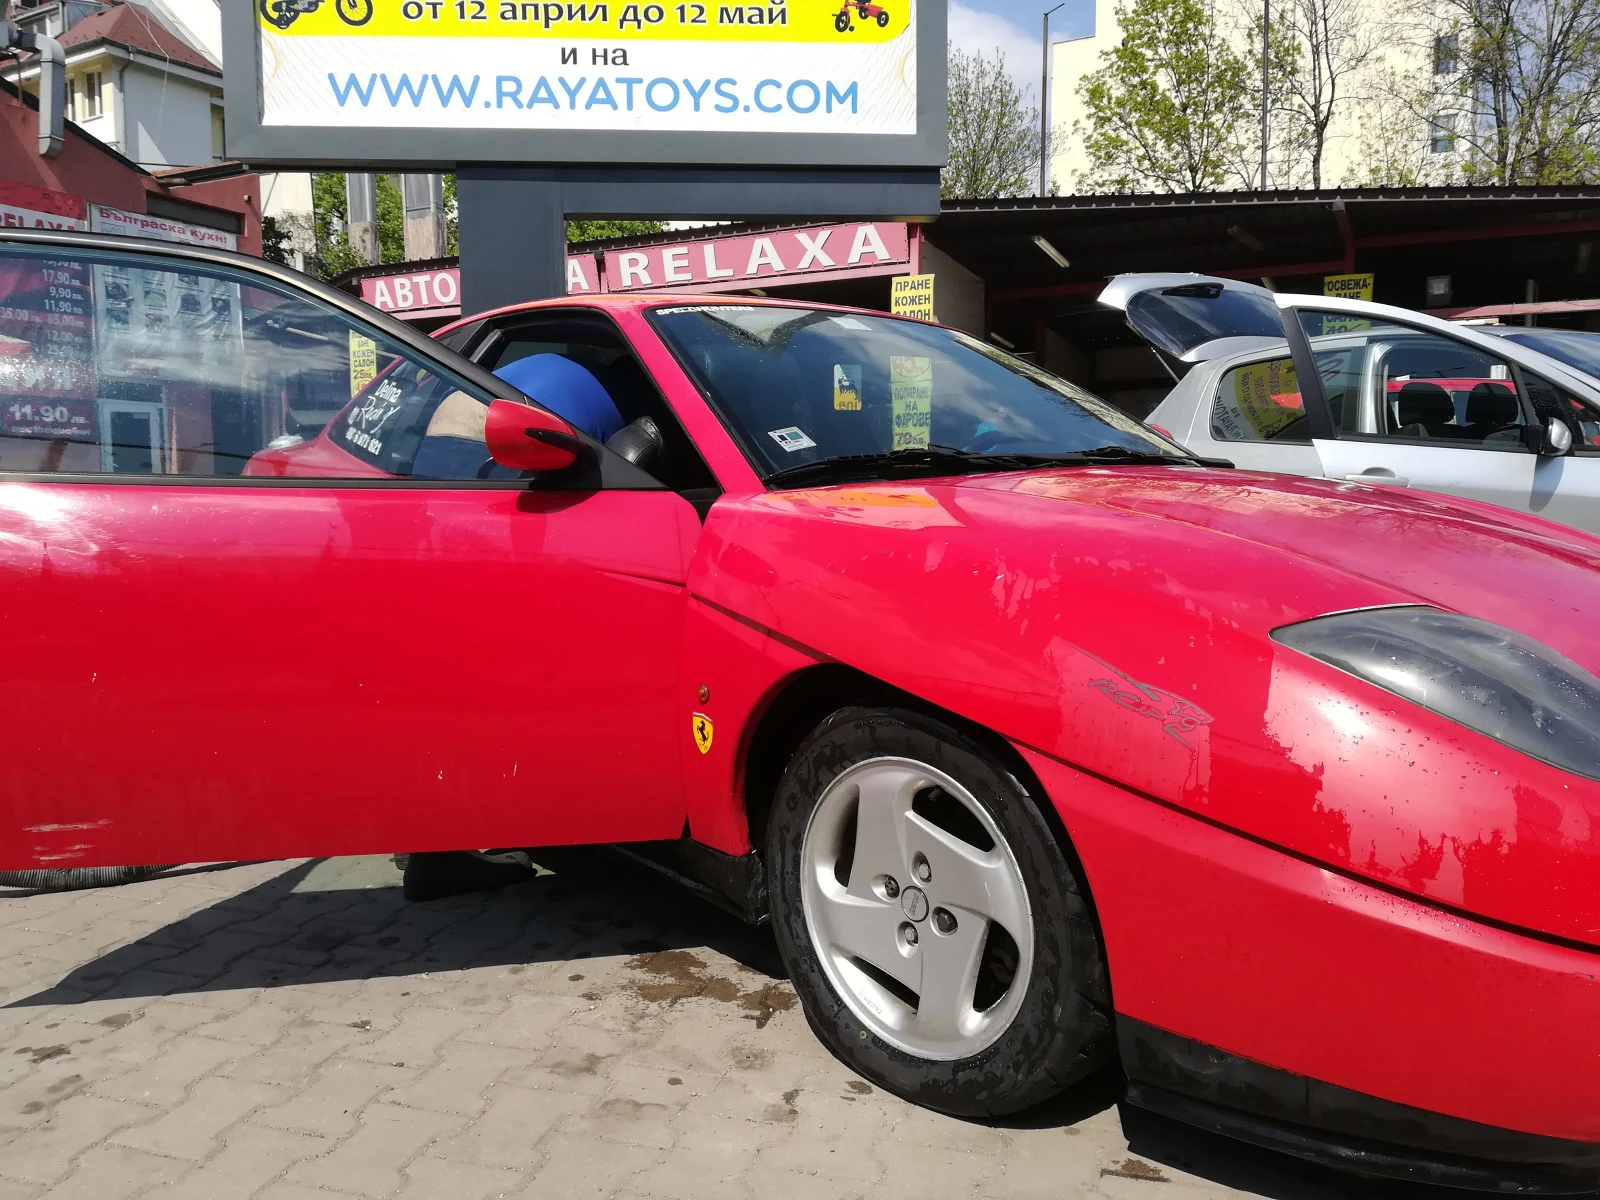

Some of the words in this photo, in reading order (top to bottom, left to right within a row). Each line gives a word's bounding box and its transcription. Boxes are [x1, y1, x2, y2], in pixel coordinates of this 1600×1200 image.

[402, 0, 443, 20] от
[457, 0, 488, 20] 12
[499, 0, 609, 29] април
[618, 3, 664, 30] до
[675, 4, 707, 24] 12
[718, 0, 788, 25] май
[560, 47, 578, 66] и
[591, 47, 630, 66] на
[327, 72, 858, 115] WWW.RAYATOYS.COM
[618, 225, 892, 288] RELAXA
[42, 268, 70, 285] 17,90
[895, 279, 931, 292] ПРАНЕ
[1327, 278, 1372, 292] ОСВЕЖА-
[49, 286, 71, 299] 9,90
[44, 299, 72, 313] 11,90
[894, 294, 931, 307] КОЖЕН
[352, 348, 375, 358] КОЖЕН
[353, 358, 375, 368] САЛОН
[905, 401, 918, 412] НА
